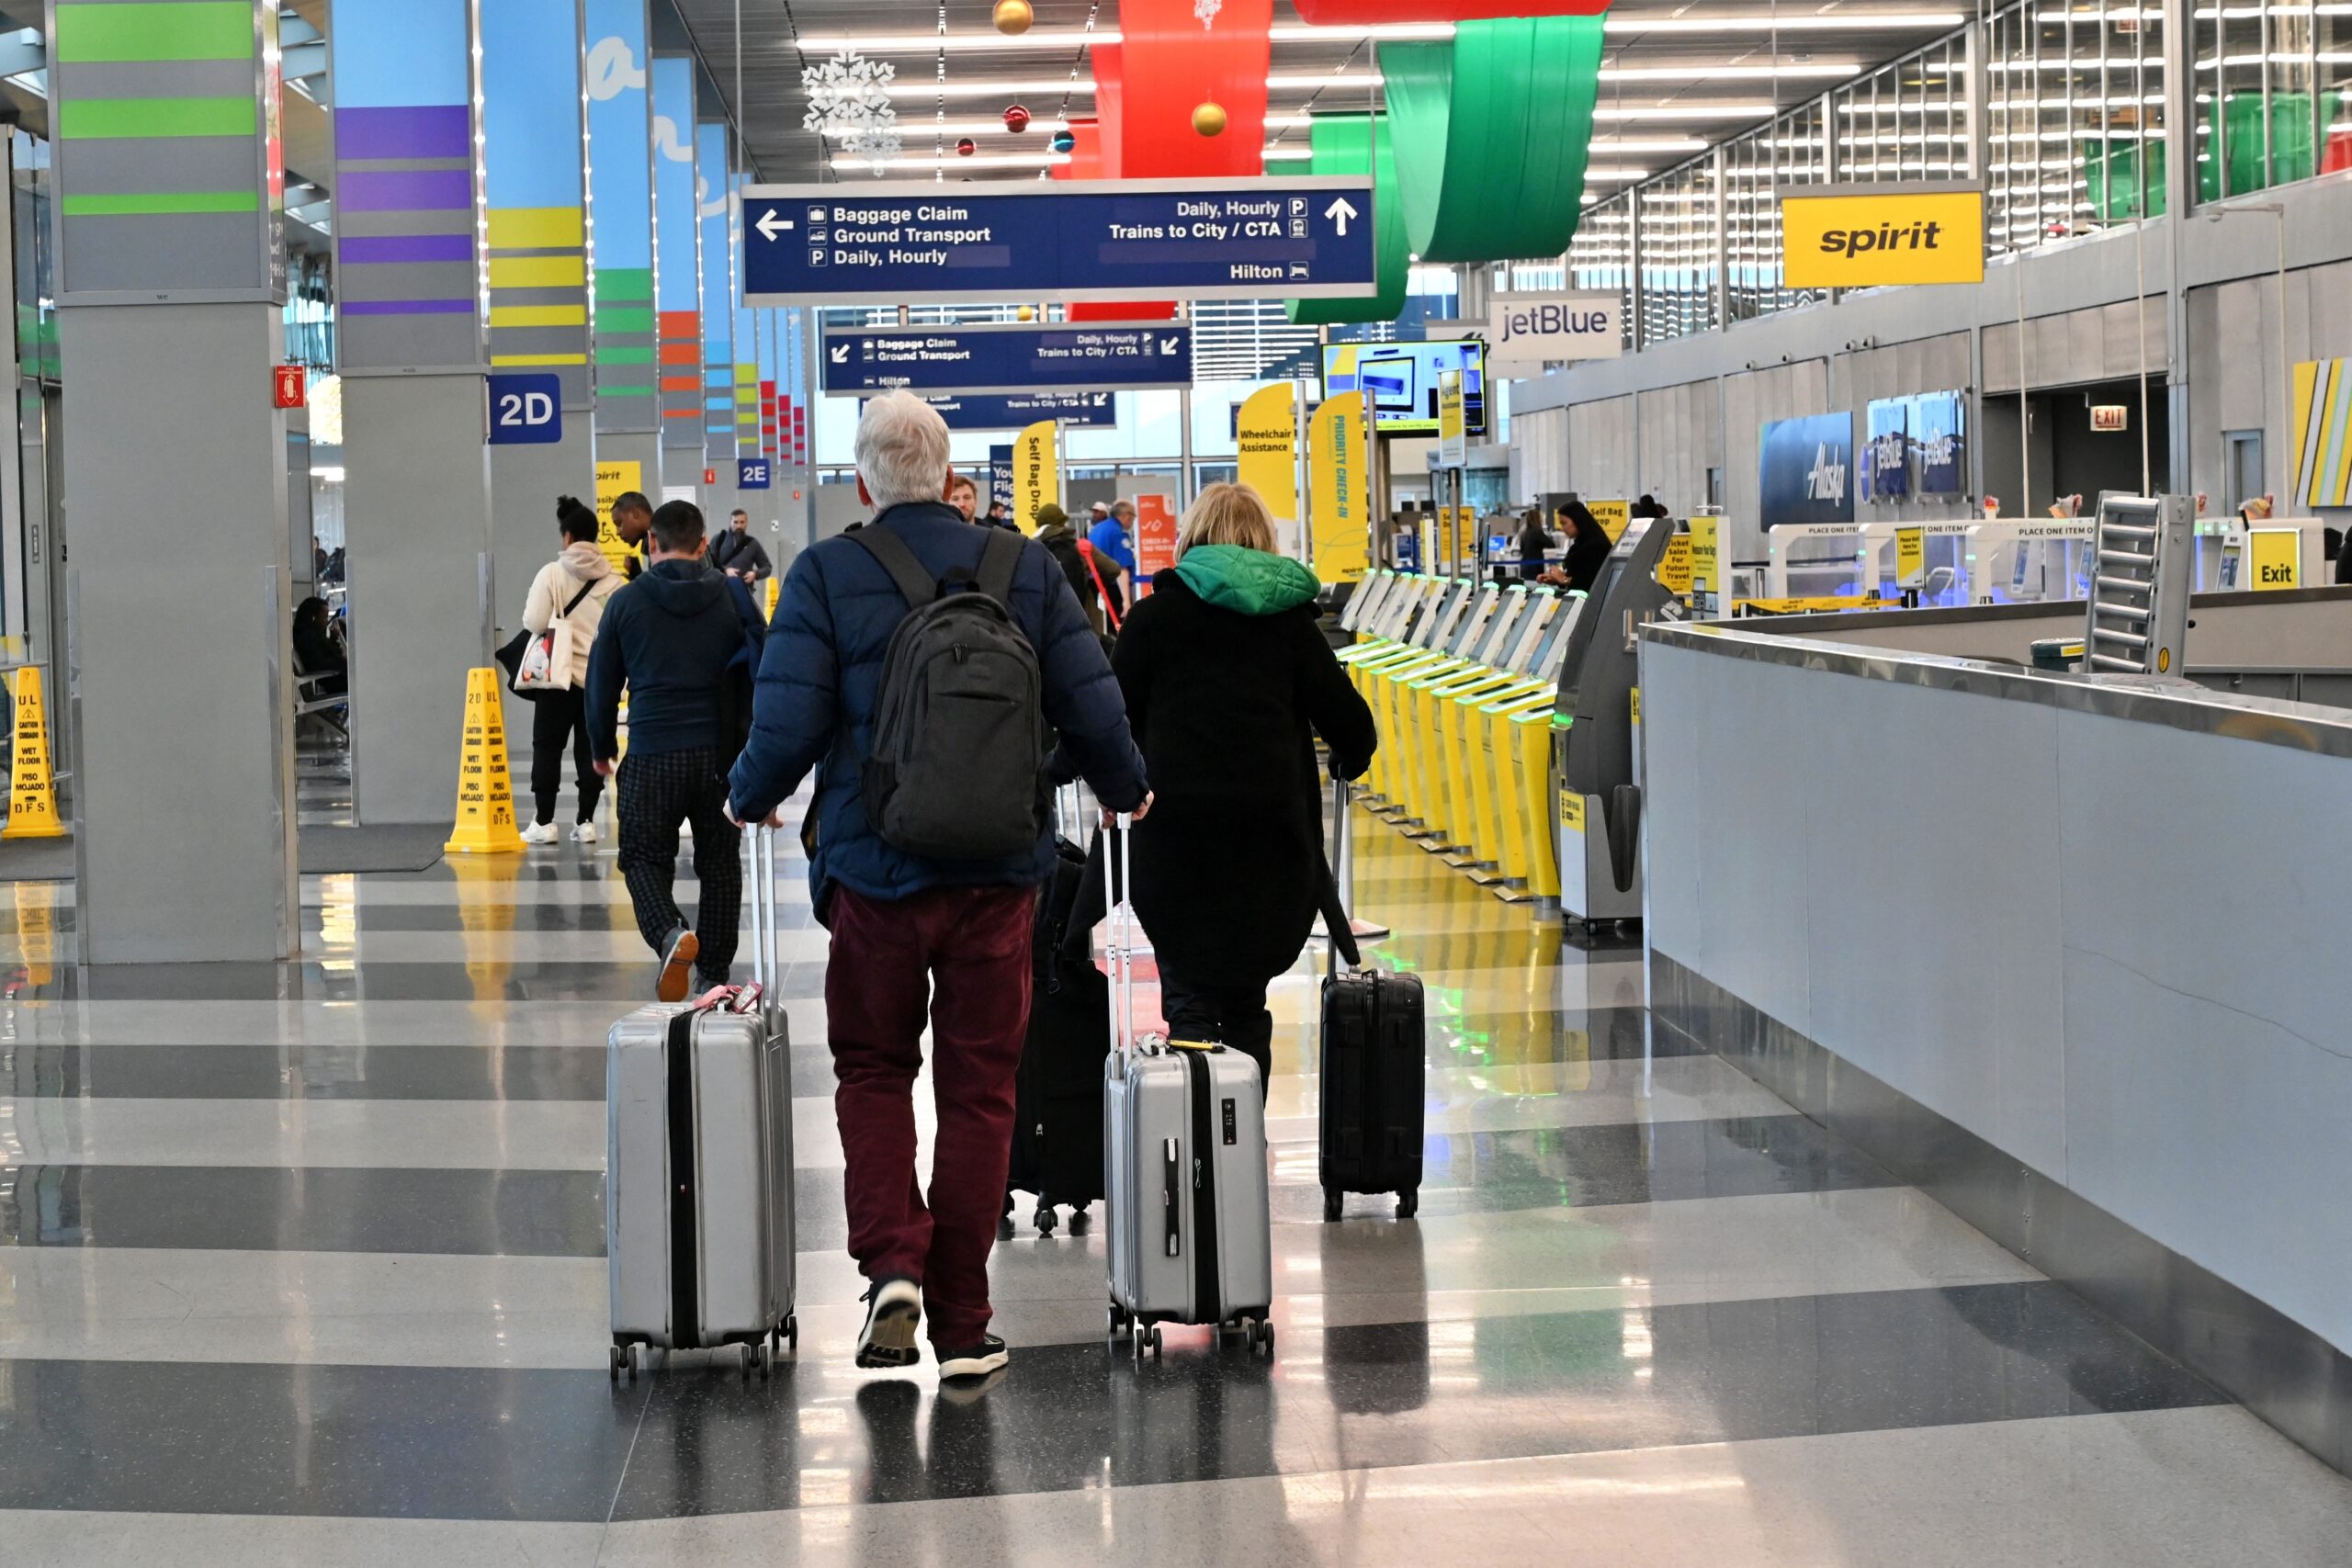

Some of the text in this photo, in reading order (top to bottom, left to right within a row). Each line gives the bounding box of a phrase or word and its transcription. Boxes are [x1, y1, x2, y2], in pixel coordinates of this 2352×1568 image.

[834, 207, 967, 224] Baggage Claim
[1177, 201, 1222, 219] Daily,
[1227, 200, 1280, 218] Hourly
[834, 228, 990, 244] Ground Transport
[1109, 222, 1281, 240] Trains to City / CTA
[1820, 221, 1940, 258] spirit
[834, 250, 883, 266] Daily,
[889, 249, 947, 265] Hourly
[1230, 265, 1283, 278] Hilton
[1501, 304, 1608, 342] jetBlue
[877, 338, 956, 351] Baggage Claim
[1077, 335, 1103, 344] Daily,
[1105, 333, 1137, 344] Hourly
[878, 350, 970, 361] Ground Transport
[1037, 347, 1069, 357] Trains
[1072, 348, 1083, 356] to
[1086, 346, 1106, 357] City
[1116, 346, 1138, 355] CTA
[878, 377, 910, 386] Hilton
[500, 392, 553, 425] 2D
[1007, 400, 1030, 408] Trains
[2096, 409, 2121, 424] EXIT
[1240, 430, 1291, 439] Wheelchair
[1029, 437, 1040, 461] Self
[1240, 443, 1288, 452] Assistance
[1924, 427, 1952, 475] jetBlue
[1876, 434, 1903, 479] jetBlue
[743, 466, 766, 481] 2E
[993, 467, 1013, 478] You
[1334, 415, 1348, 518] PRIORITY CHECK-IN
[1807, 441, 1845, 507] Alaska
[596, 471, 620, 479] pirit
[1028, 464, 1040, 487] Bag
[1608, 508, 1623, 517] Bag
[2262, 563, 2292, 582] Exit
[466, 783, 479, 791] PISO
[493, 782, 504, 790] PISO
[490, 793, 510, 801] MOJADO
